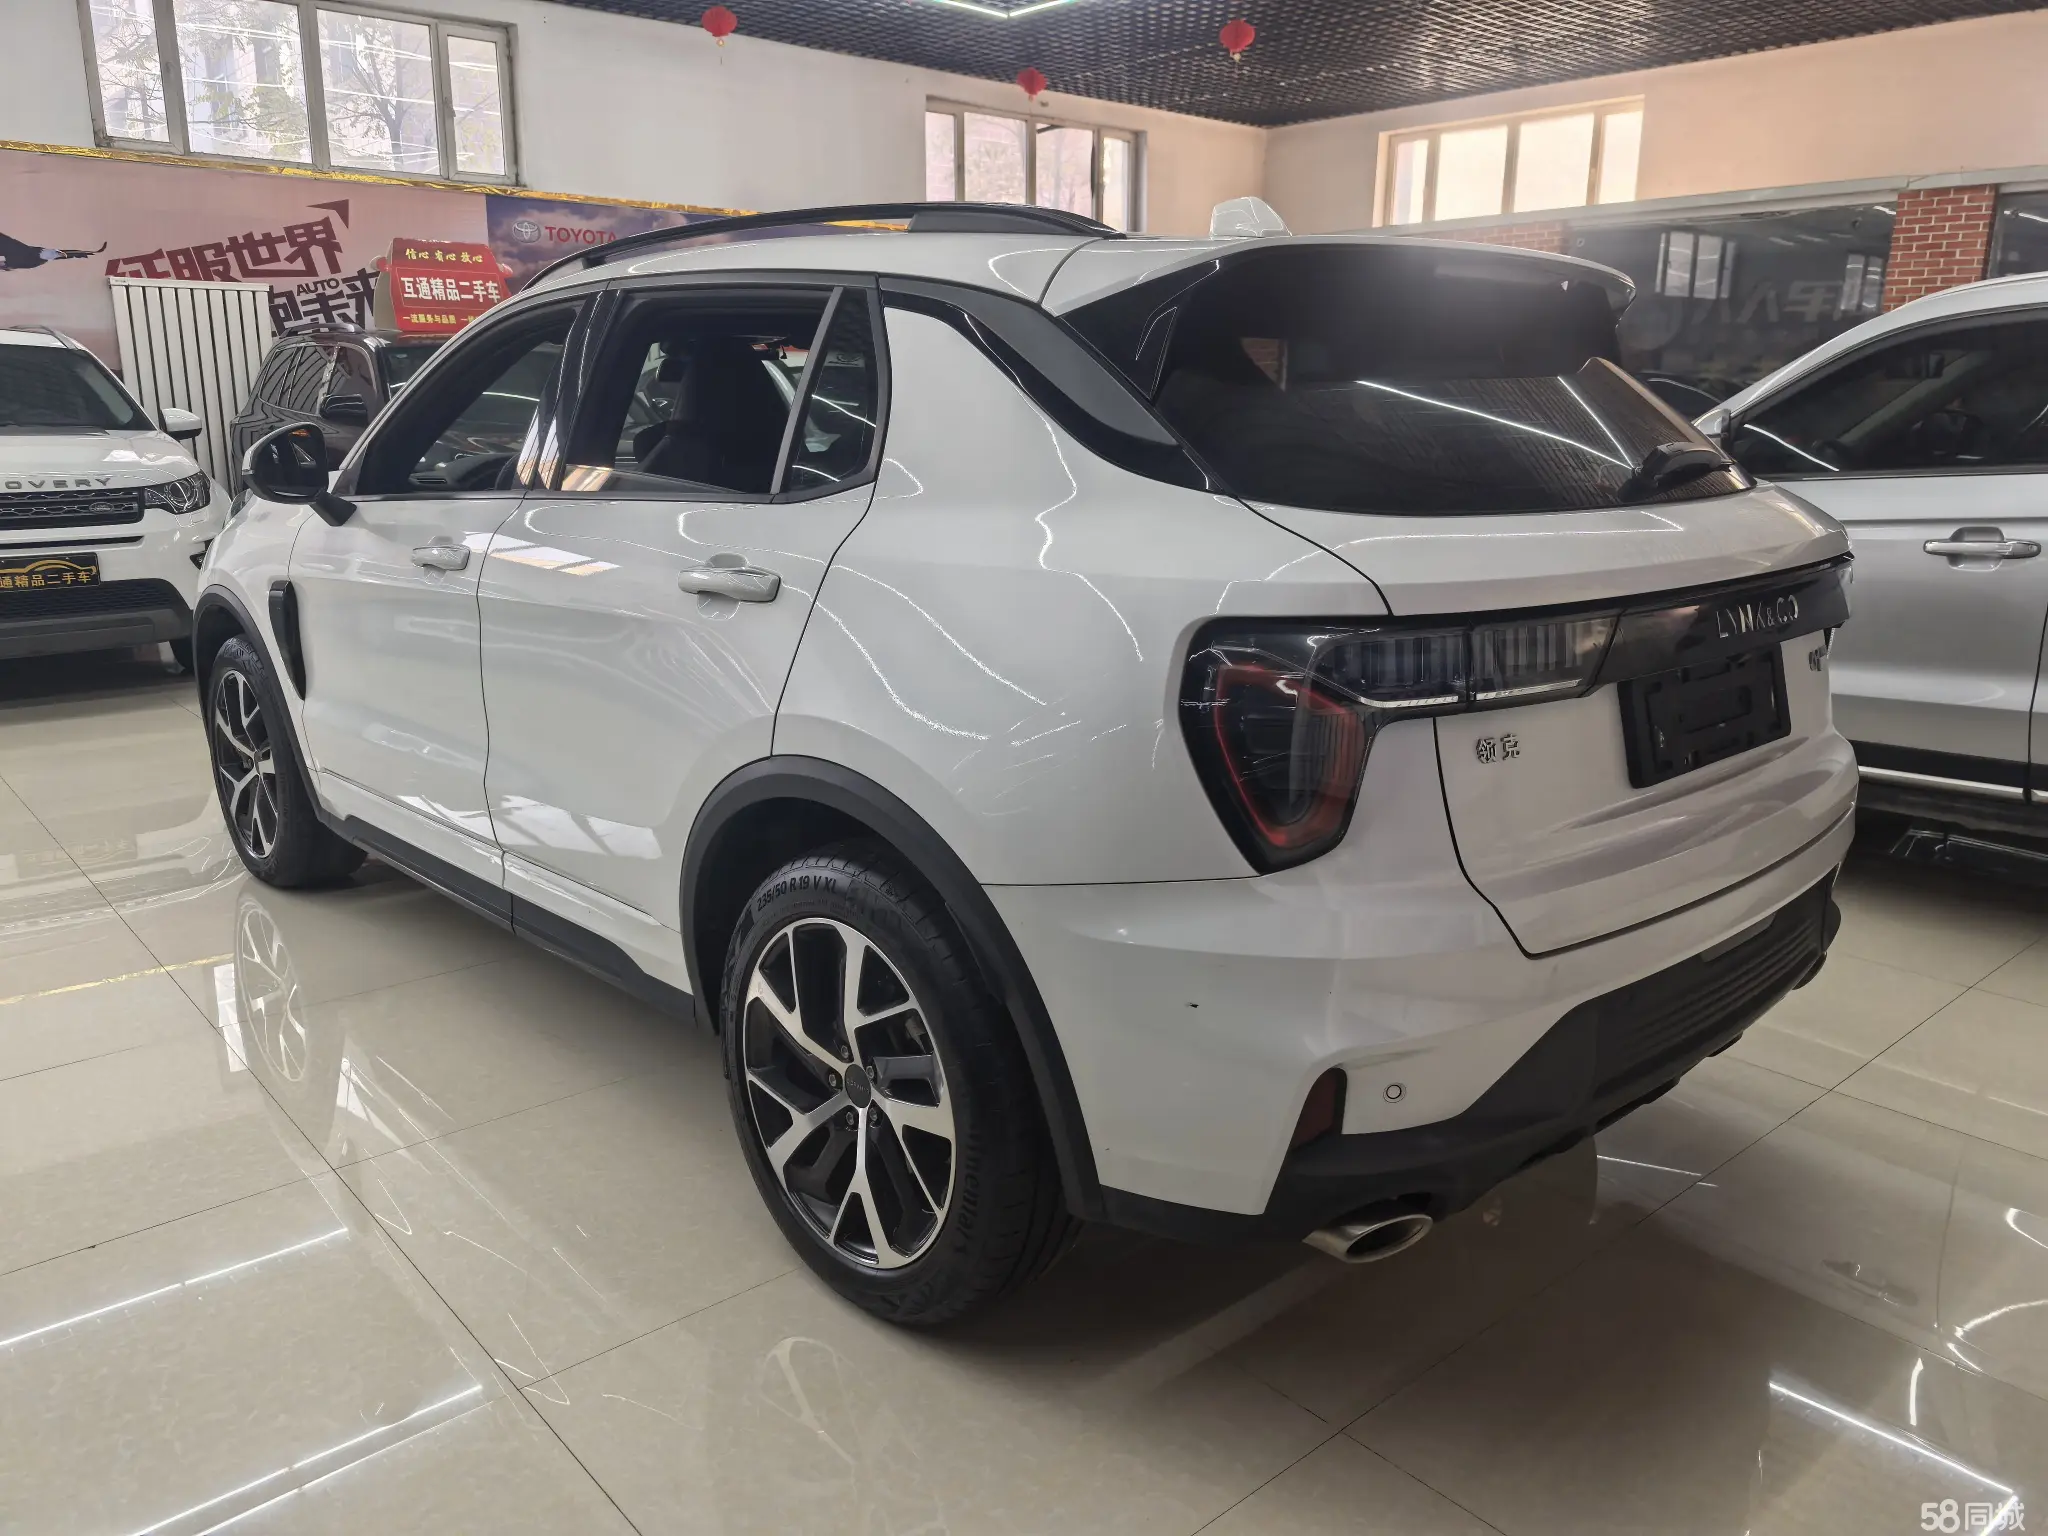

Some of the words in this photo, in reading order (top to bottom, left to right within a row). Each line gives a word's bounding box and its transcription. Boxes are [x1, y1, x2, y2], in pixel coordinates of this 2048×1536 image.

[544, 226, 618, 245] TOYOTA
[296, 277, 341, 297] AUTO
[400, 276, 501, 303] 互通精品二手车
[1475, 733, 1521, 764] 领克
[756, 880, 788, 912] 235/50
[789, 877, 797, 893] R
[799, 875, 810, 890] 19
[813, 875, 823, 891] V
[824, 876, 838, 894] XL
